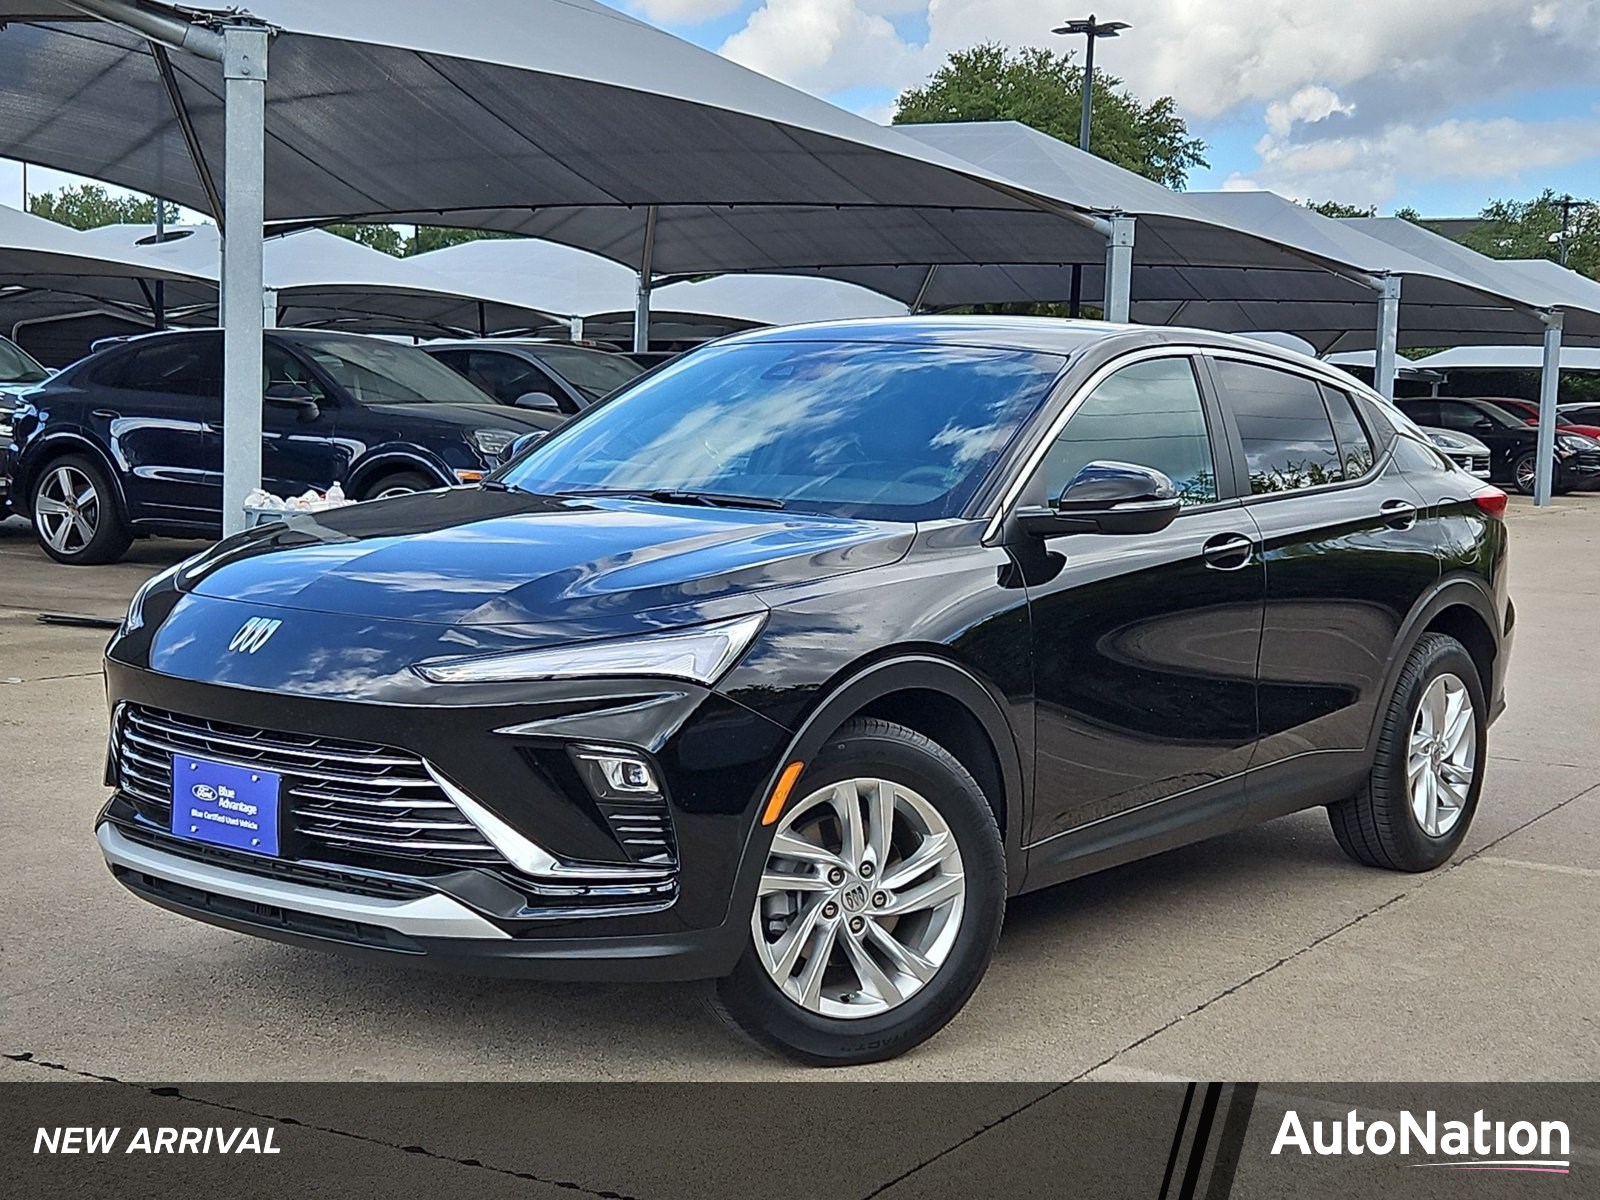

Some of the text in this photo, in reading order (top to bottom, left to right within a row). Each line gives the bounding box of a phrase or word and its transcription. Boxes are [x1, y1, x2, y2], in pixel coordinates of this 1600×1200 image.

[218, 785, 236, 799] Blue
[218, 798, 257, 815] Advantage
[191, 808, 258, 830] Blue Certified Used Vehicle
